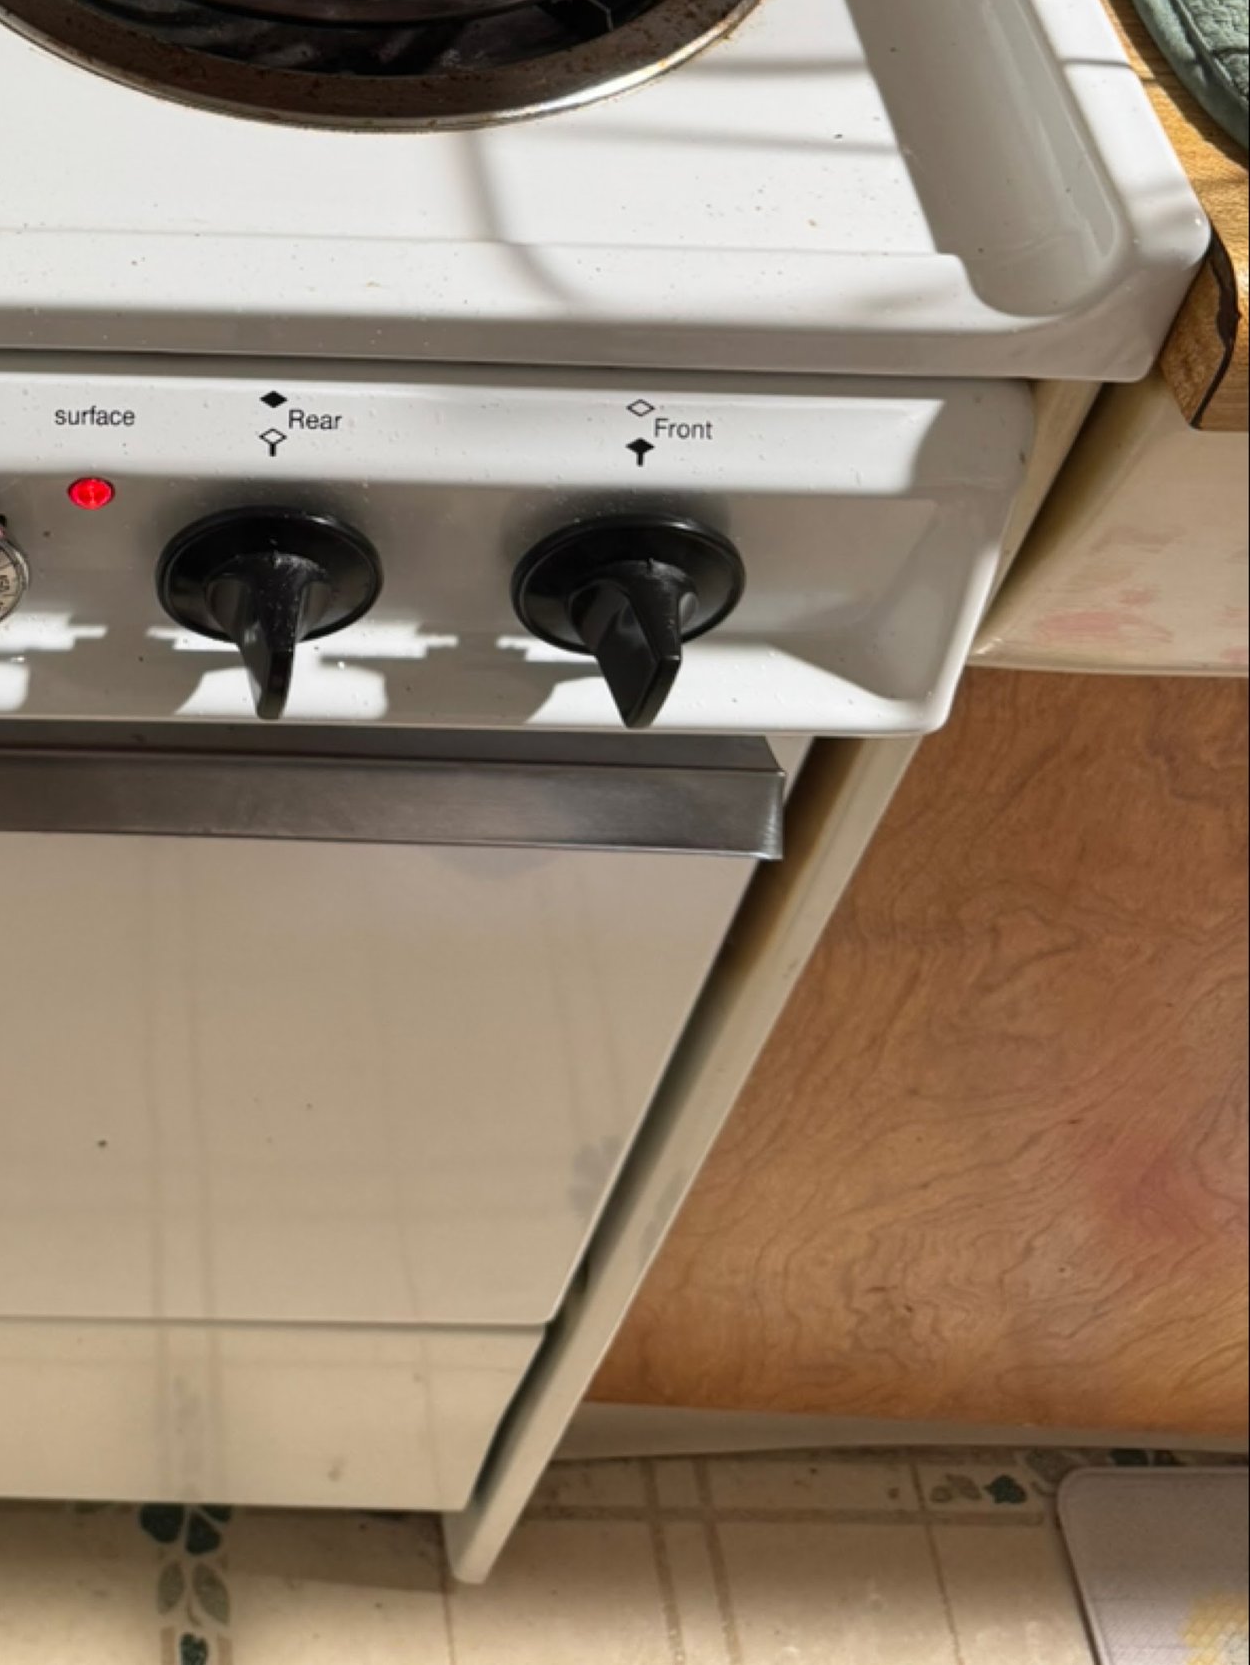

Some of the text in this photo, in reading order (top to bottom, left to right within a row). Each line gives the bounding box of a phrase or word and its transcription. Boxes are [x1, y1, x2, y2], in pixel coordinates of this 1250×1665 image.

[54, 404, 136, 426] surface
[288, 408, 343, 430] Rear
[654, 417, 713, 440] Front
